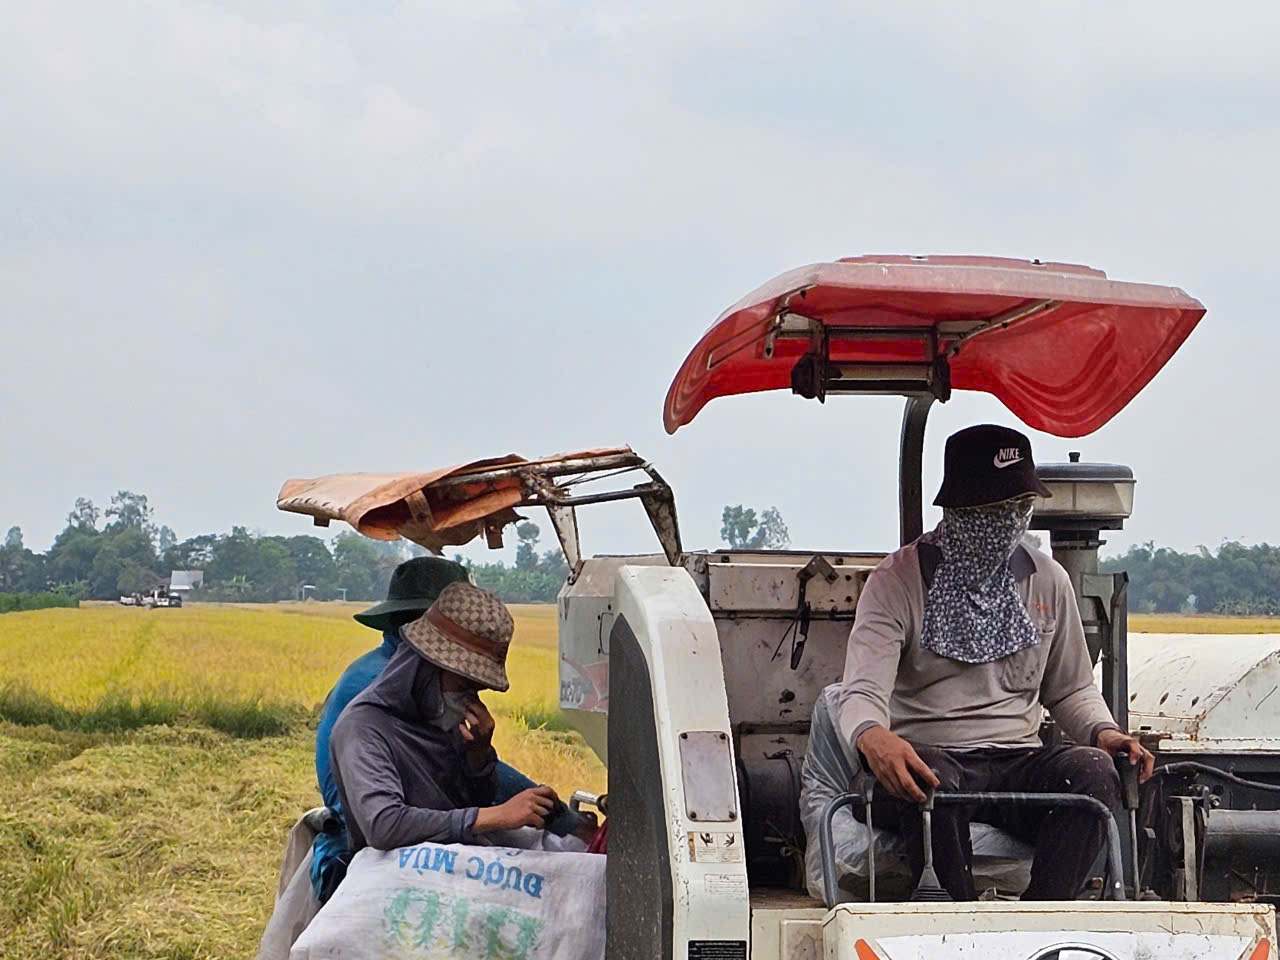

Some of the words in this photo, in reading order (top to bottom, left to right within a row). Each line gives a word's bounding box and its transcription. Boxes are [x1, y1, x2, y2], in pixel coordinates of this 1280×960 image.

[998, 447, 1021, 460] NIKE
[399, 847, 458, 876] MÙA
[465, 857, 545, 899] ĐƯỢC
